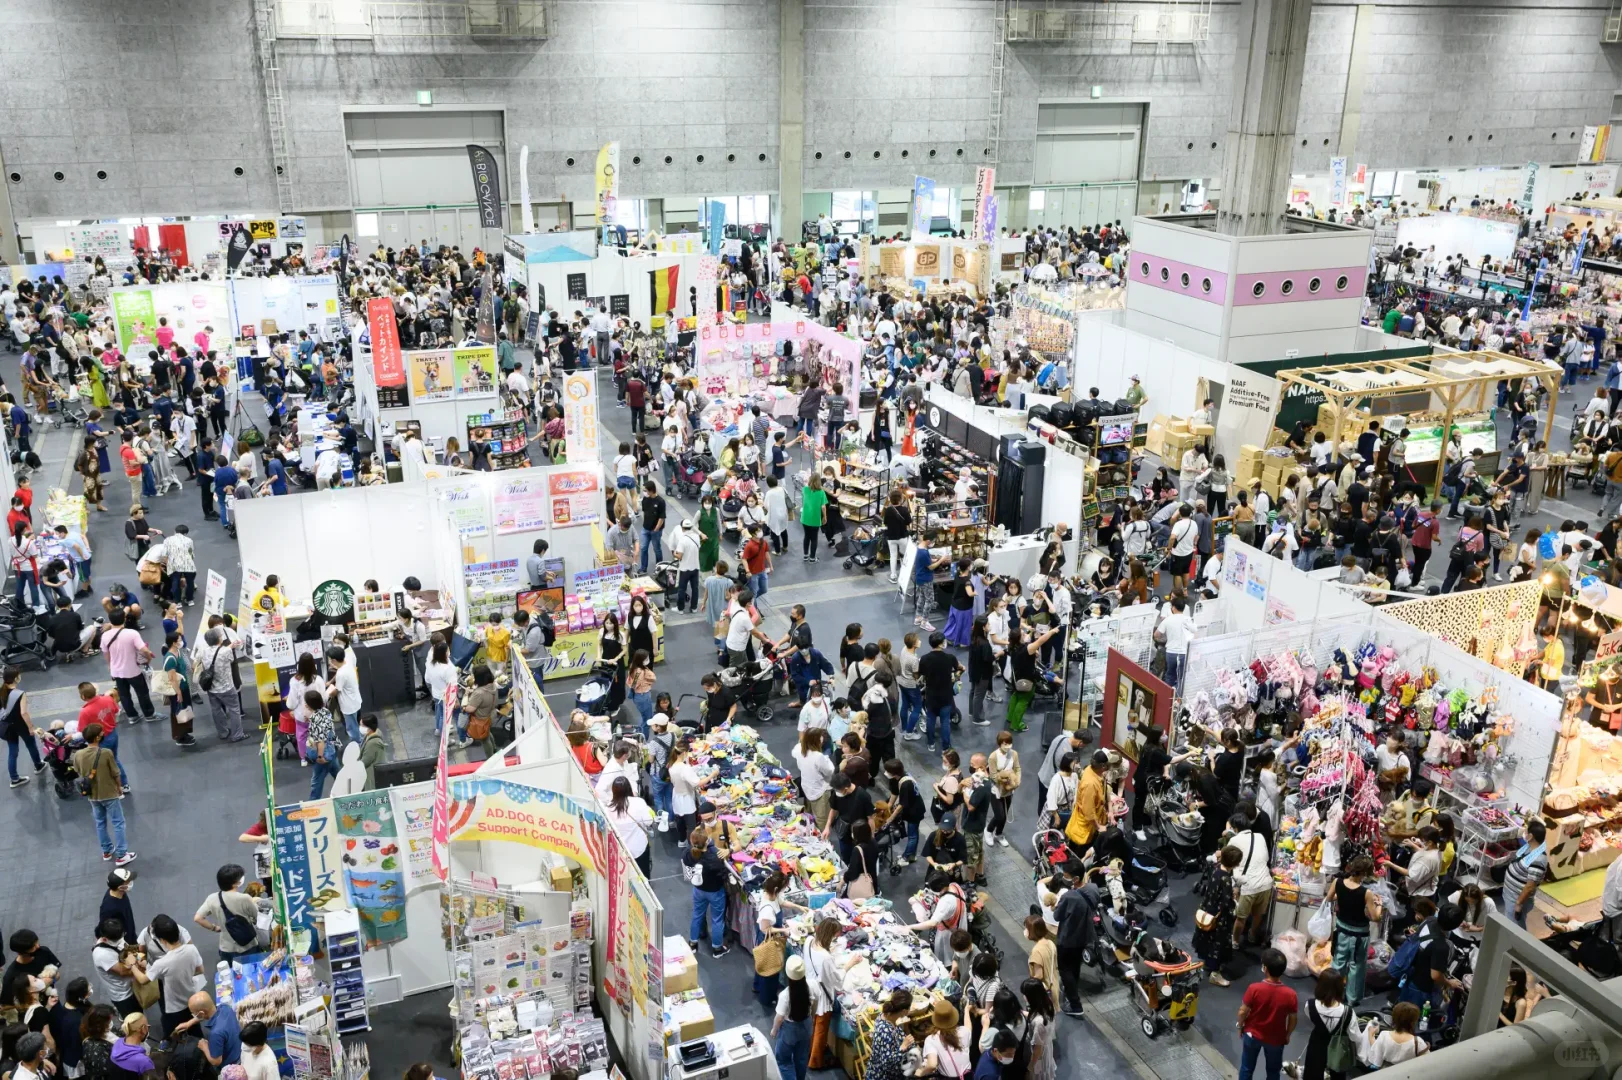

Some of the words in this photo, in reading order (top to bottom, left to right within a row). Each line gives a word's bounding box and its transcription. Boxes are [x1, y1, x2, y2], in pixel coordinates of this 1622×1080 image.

[377, 314, 390, 371] ペットカインド
[1231, 379, 1247, 388] NAAF
[1230, 387, 1270, 402] Additive-Free
[1229, 398, 1254, 408] Premium
[1255, 402, 1270, 412] Food
[448, 493, 469, 502] Wish
[505, 485, 528, 495] Wish
[545, 652, 587, 672] Wsh
[486, 807, 535, 826] AD.DOG
[538, 817, 548, 828] &
[551, 820, 575, 836] CAT
[276, 824, 301, 835] 無添加
[477, 822, 528, 837] Support
[531, 829, 580, 855] Company
[280, 854, 305, 864] まるごと
[309, 816, 336, 890] フリーズ
[287, 868, 306, 924] ドライ
